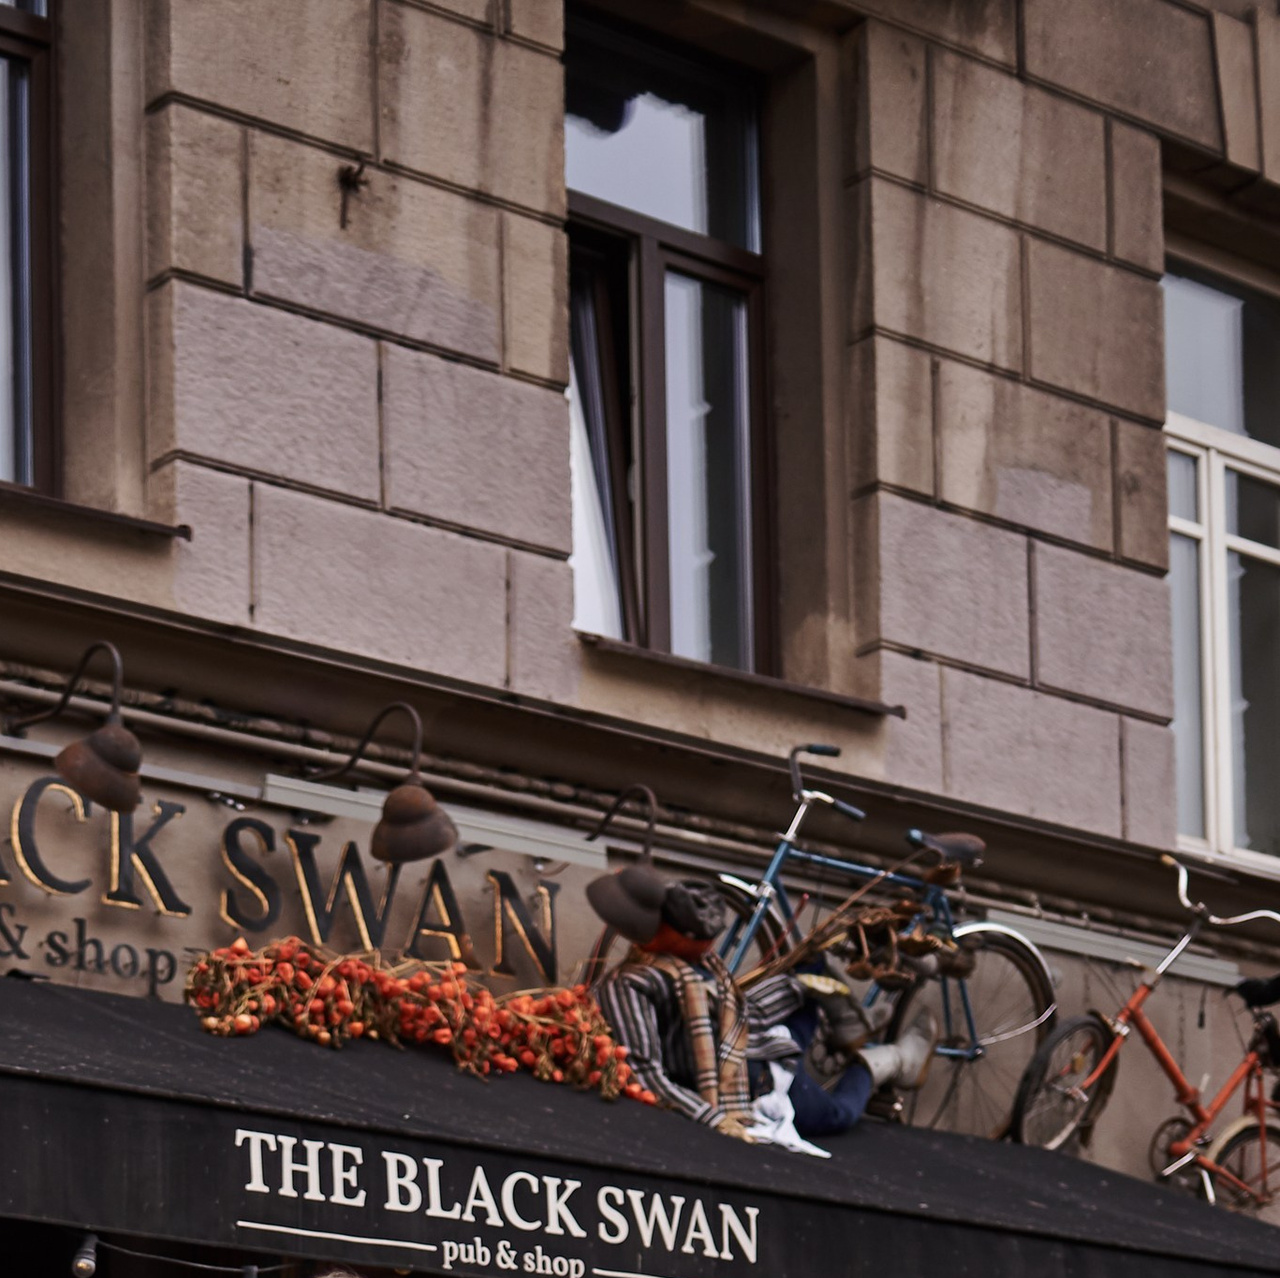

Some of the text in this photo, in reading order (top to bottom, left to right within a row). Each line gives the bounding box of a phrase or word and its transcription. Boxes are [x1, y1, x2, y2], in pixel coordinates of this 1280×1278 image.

[220, 816, 561, 986] SWAN
[44, 917, 178, 1000] shop
[235, 1128, 759, 1264] THE BLACK SWAN
[441, 1236, 491, 1270] pub
[495, 1239, 518, 1270] &
